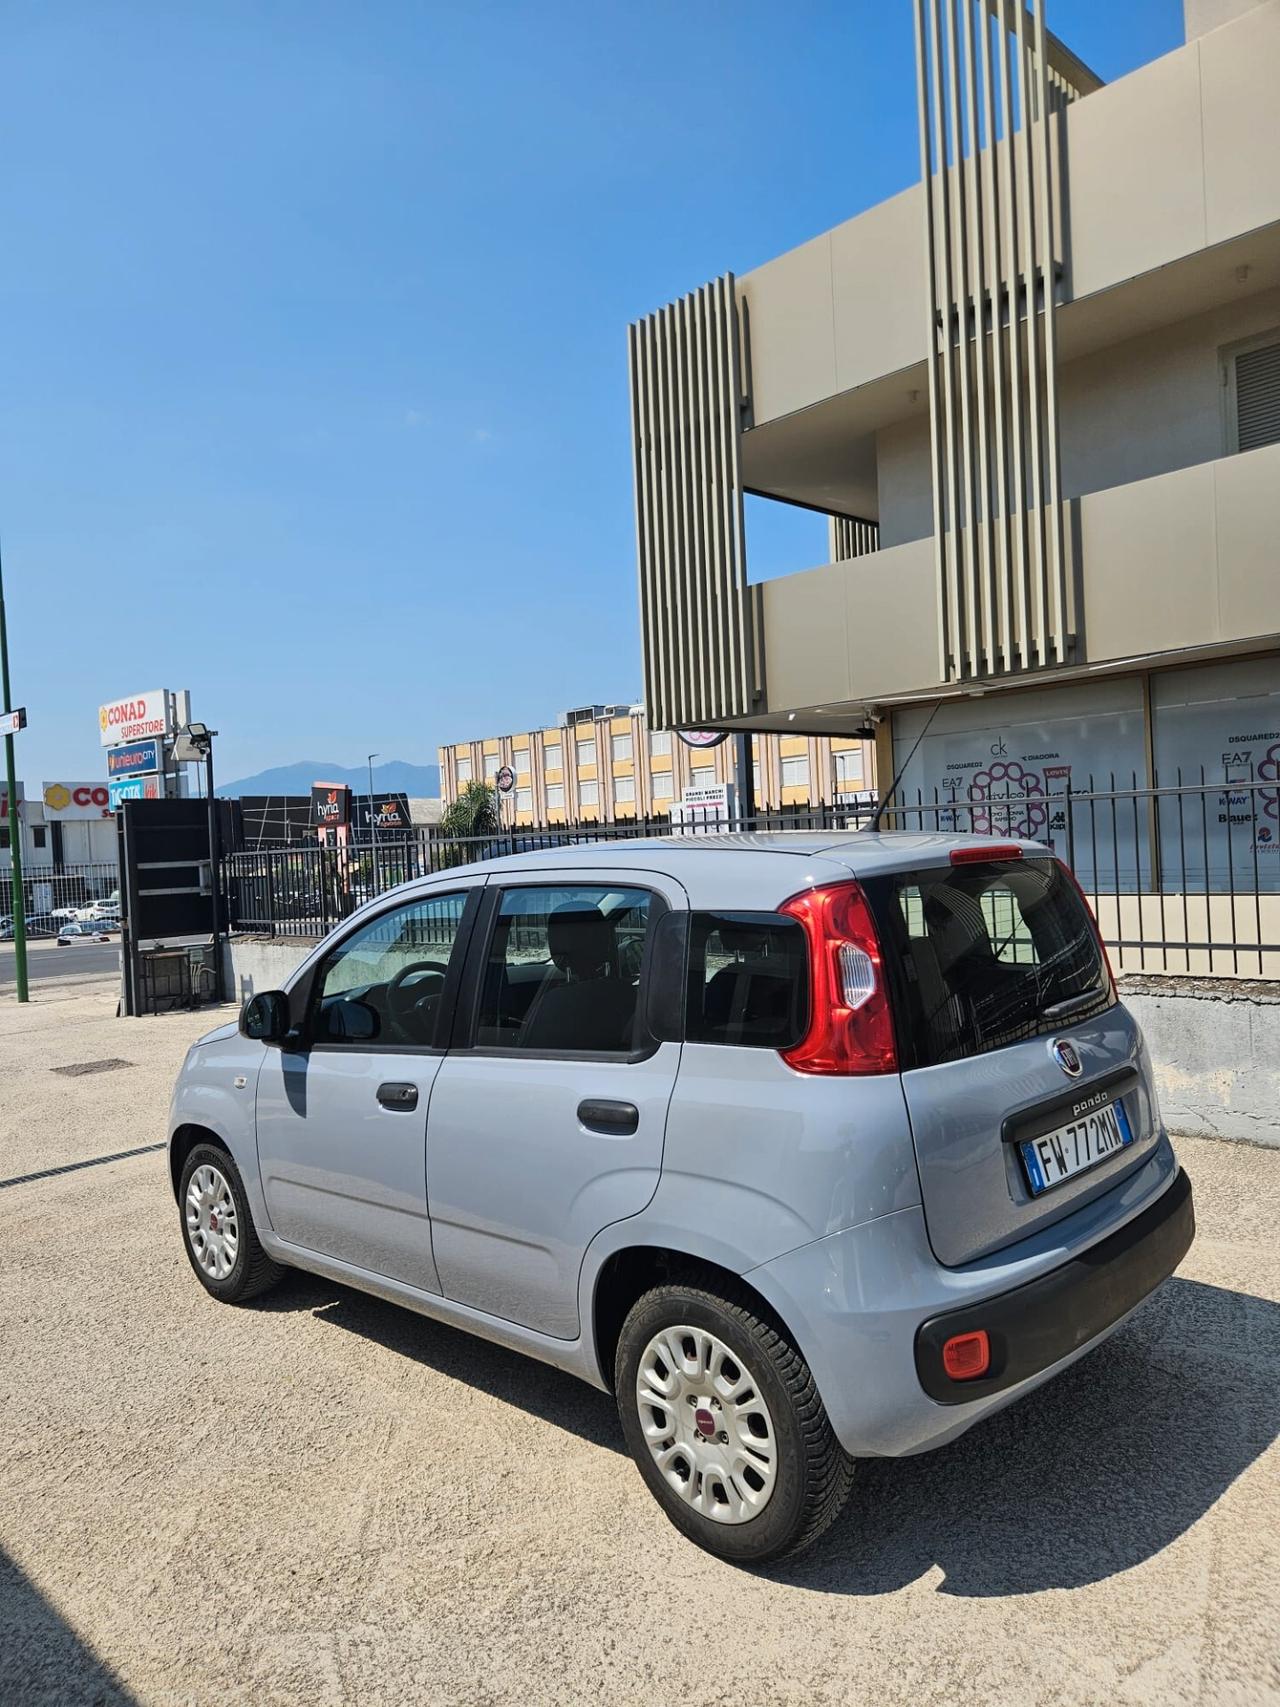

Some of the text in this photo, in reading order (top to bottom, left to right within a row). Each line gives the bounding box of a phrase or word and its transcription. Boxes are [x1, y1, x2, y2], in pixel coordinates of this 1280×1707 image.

[108, 700, 146, 725] CONAD
[121, 719, 164, 739] SUPERSTORE
[115, 750, 155, 768] unieuro CITY
[1221, 751, 1252, 764] EA7
[317, 801, 339, 819] hyria
[1072, 1092, 1108, 1117] panda
[1037, 1108, 1122, 1183] FW 772MW
